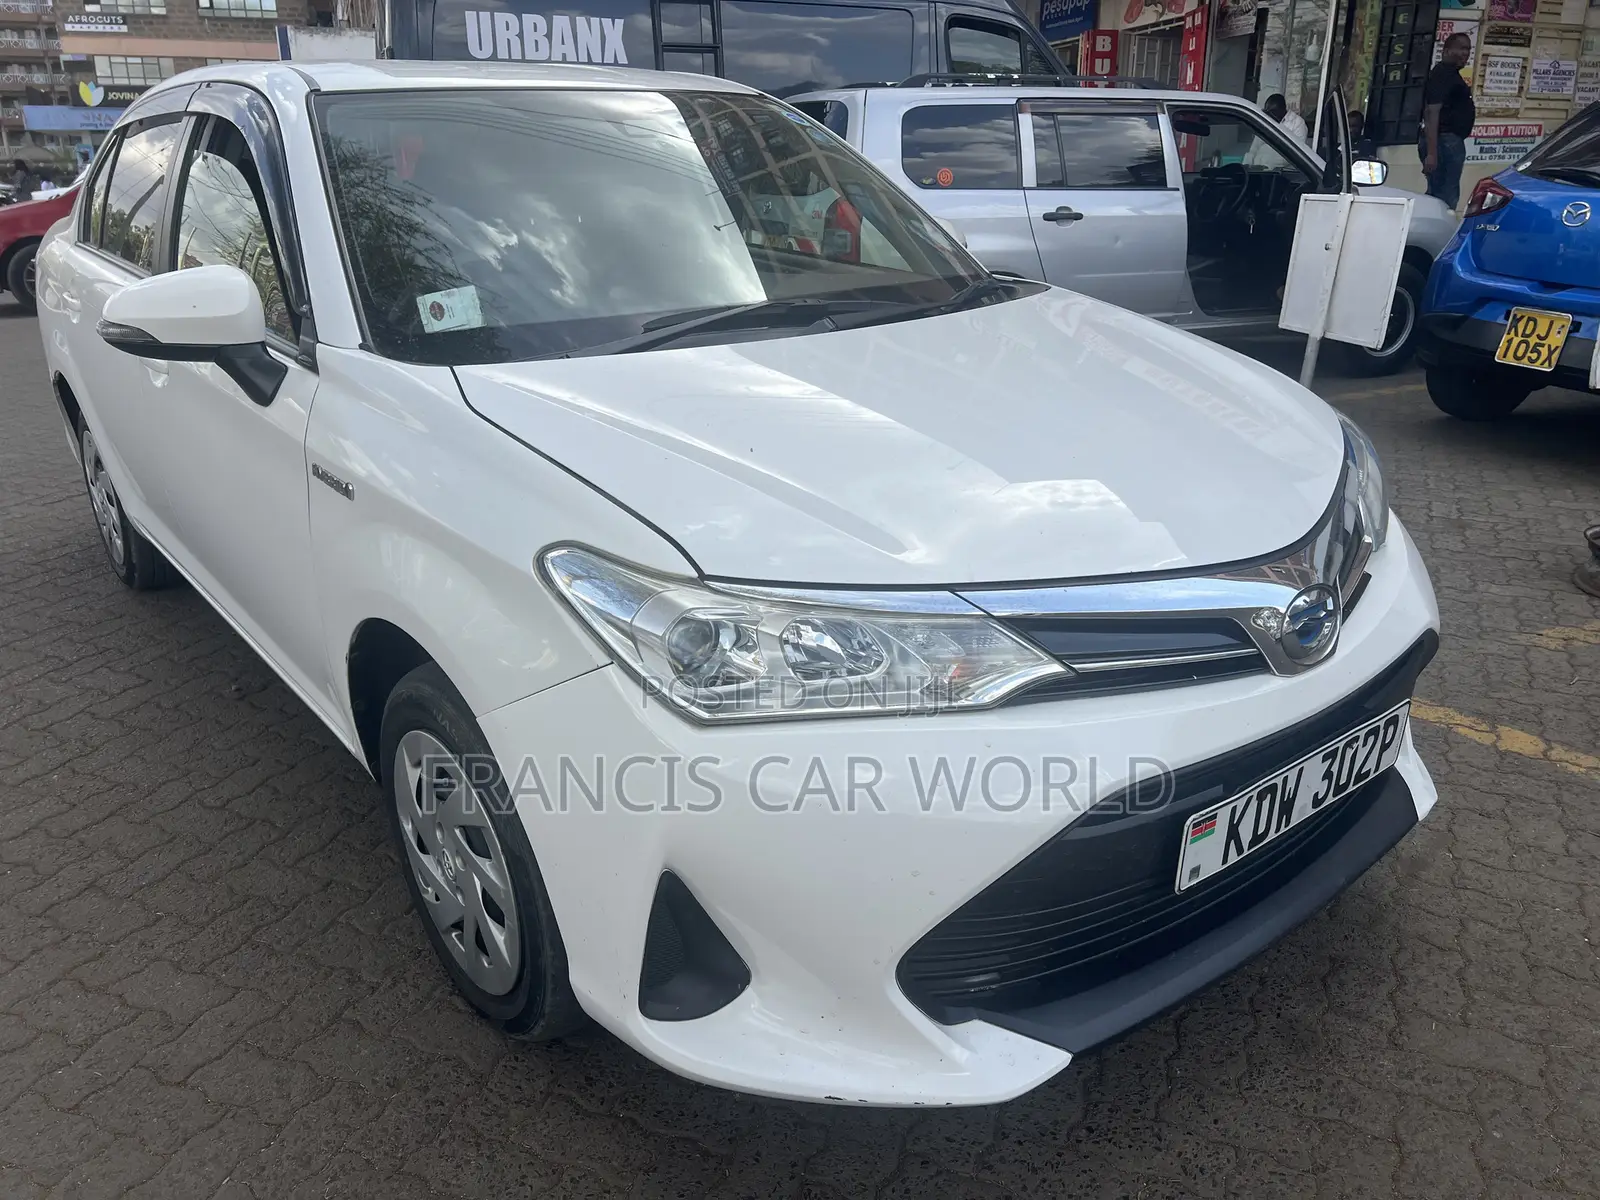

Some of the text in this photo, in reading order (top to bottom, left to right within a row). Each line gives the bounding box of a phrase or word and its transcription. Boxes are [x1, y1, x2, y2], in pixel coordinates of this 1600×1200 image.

[67, 14, 124, 24] AFROCUTS
[464, 10, 629, 65] URBANX
[1500, 61, 1521, 69] BOOKS
[1532, 68, 1575, 77] PILLARS AGENCIES
[107, 92, 141, 100] JOVINA
[1470, 125, 1538, 136] HOLIDAY TUITION
[1506, 313, 1554, 341] KDJ
[1502, 337, 1561, 368] 105X
[1221, 713, 1400, 866] KDW 302P
